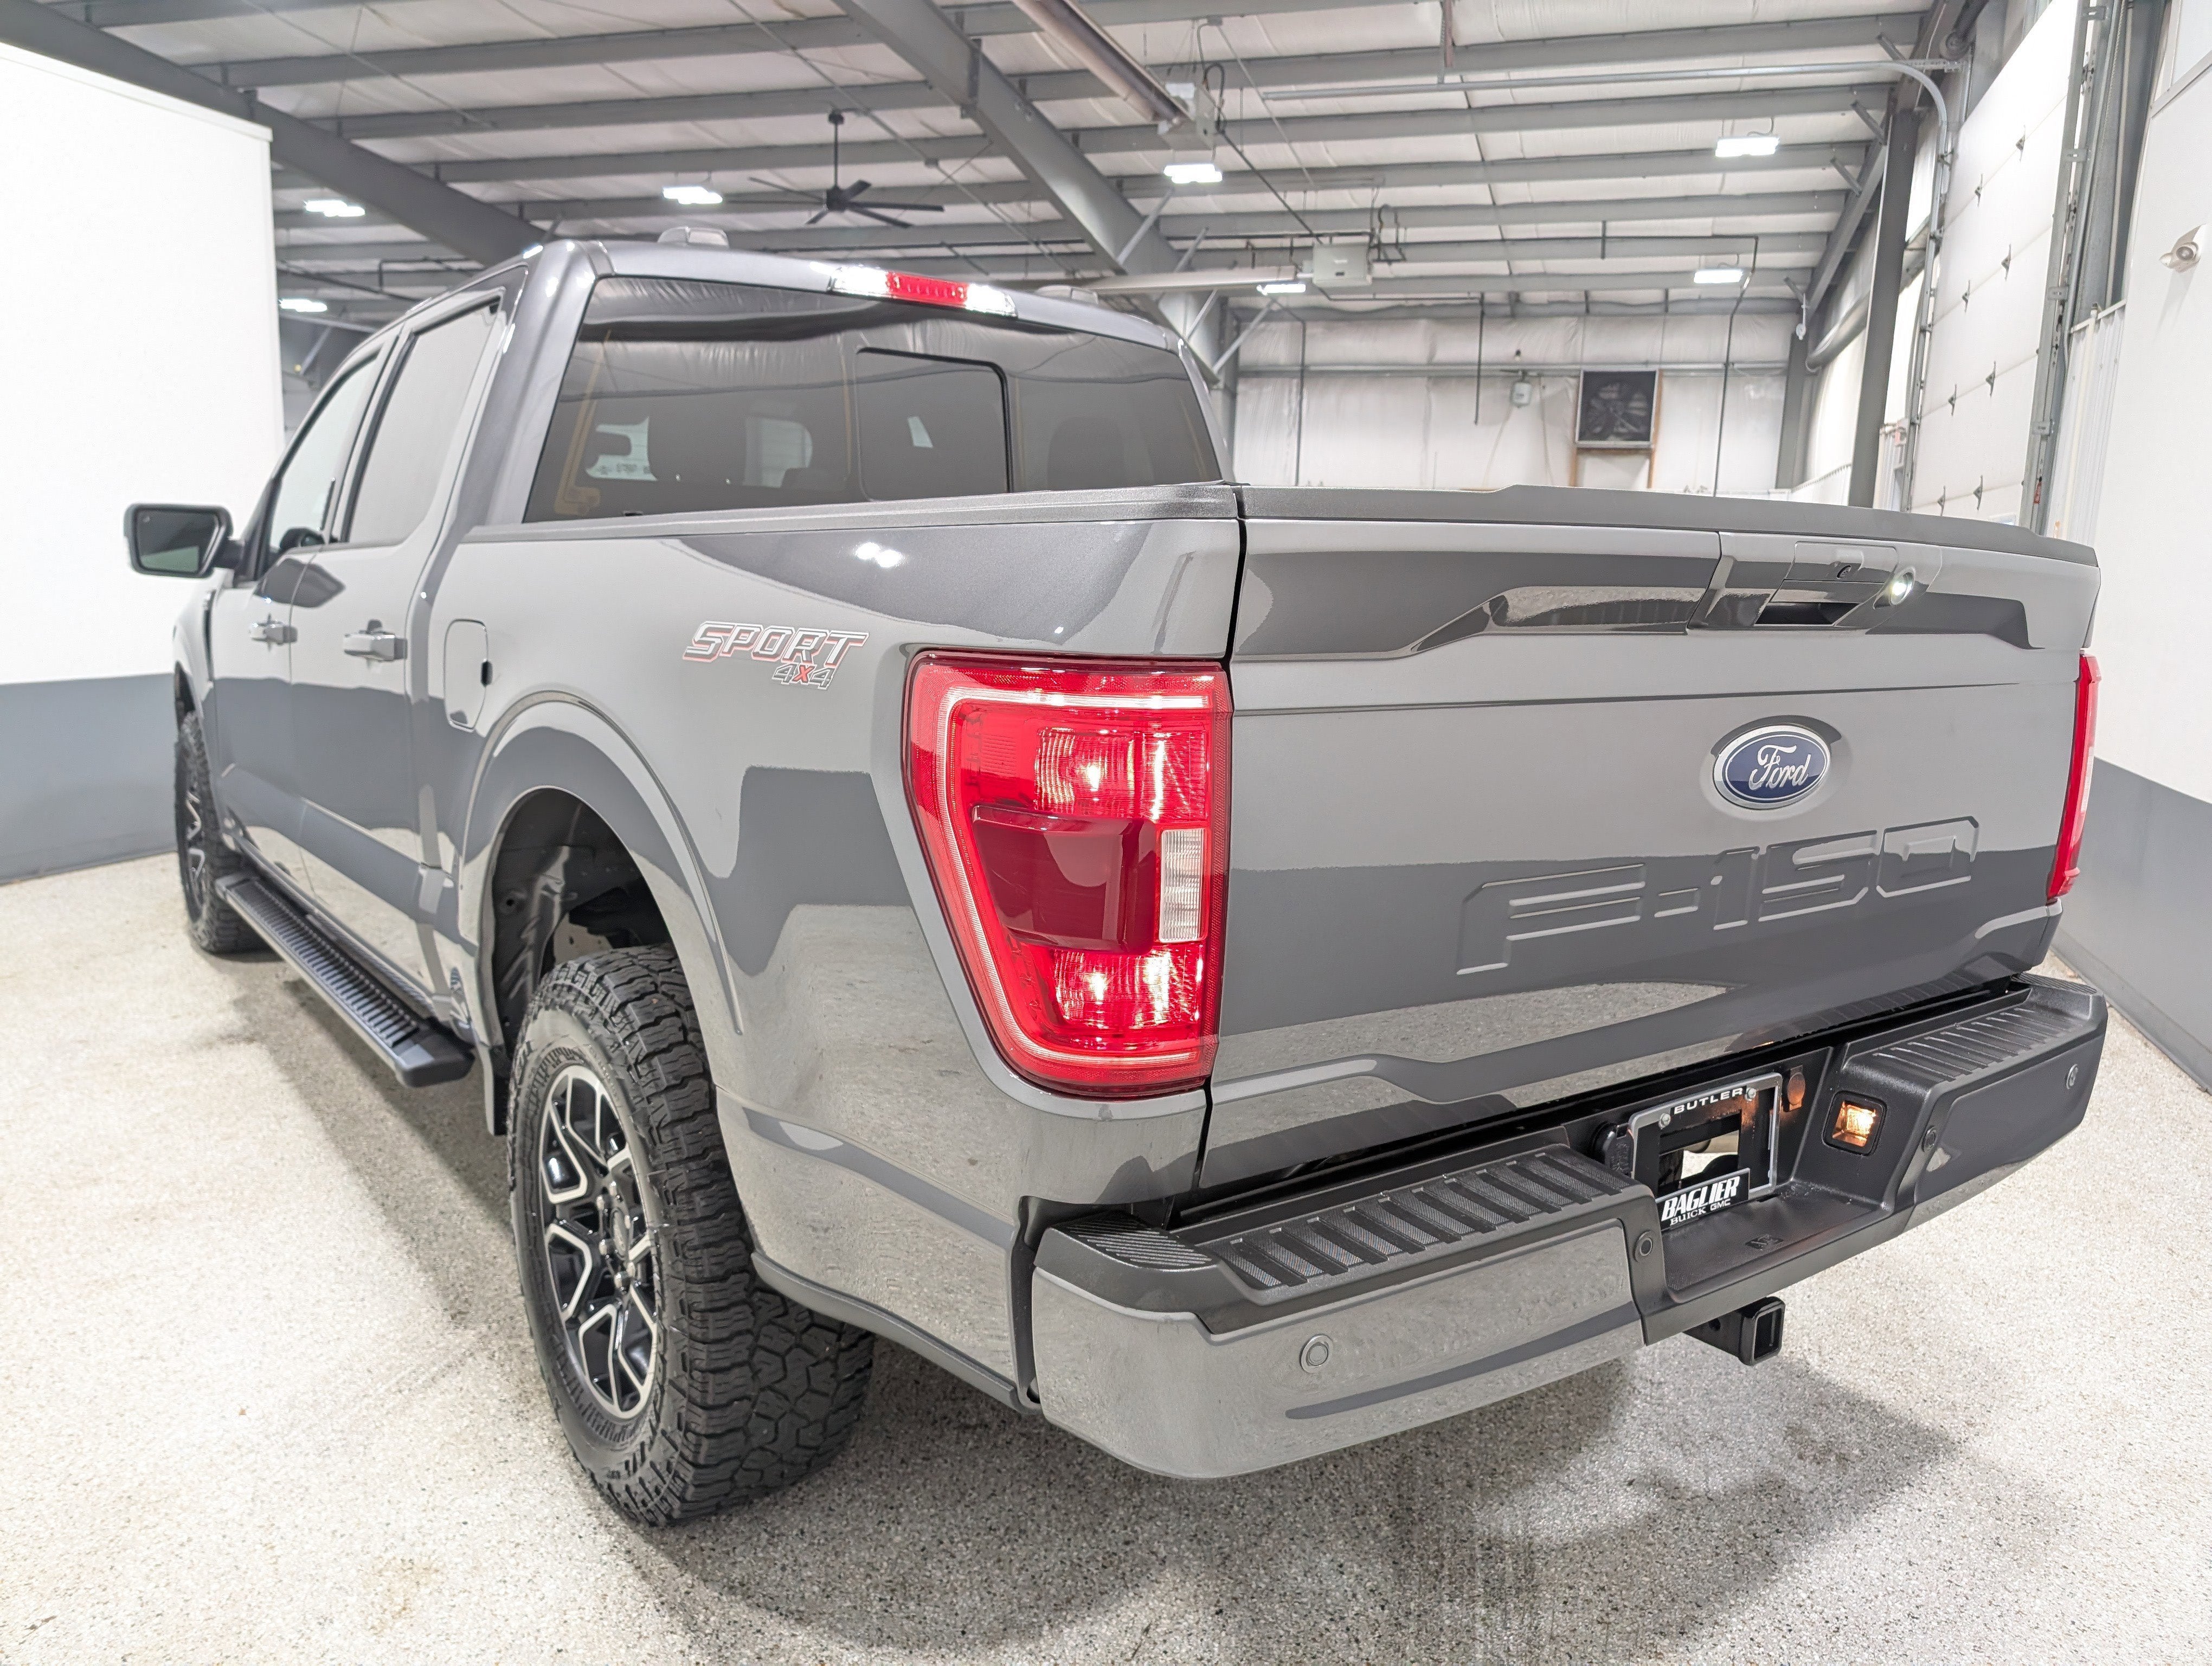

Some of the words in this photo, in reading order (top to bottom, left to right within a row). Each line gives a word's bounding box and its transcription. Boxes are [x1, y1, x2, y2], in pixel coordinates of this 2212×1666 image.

[682, 620, 869, 668] SPORT
[1748, 744, 1812, 791] Ford
[1456, 815, 1979, 976] F-150
[1674, 1087, 1743, 1115] BUTLER
[1661, 1176, 1740, 1222] BAGLIER
[1670, 1208, 1706, 1226] BUICK
[1709, 1198, 1731, 1212] GMC
